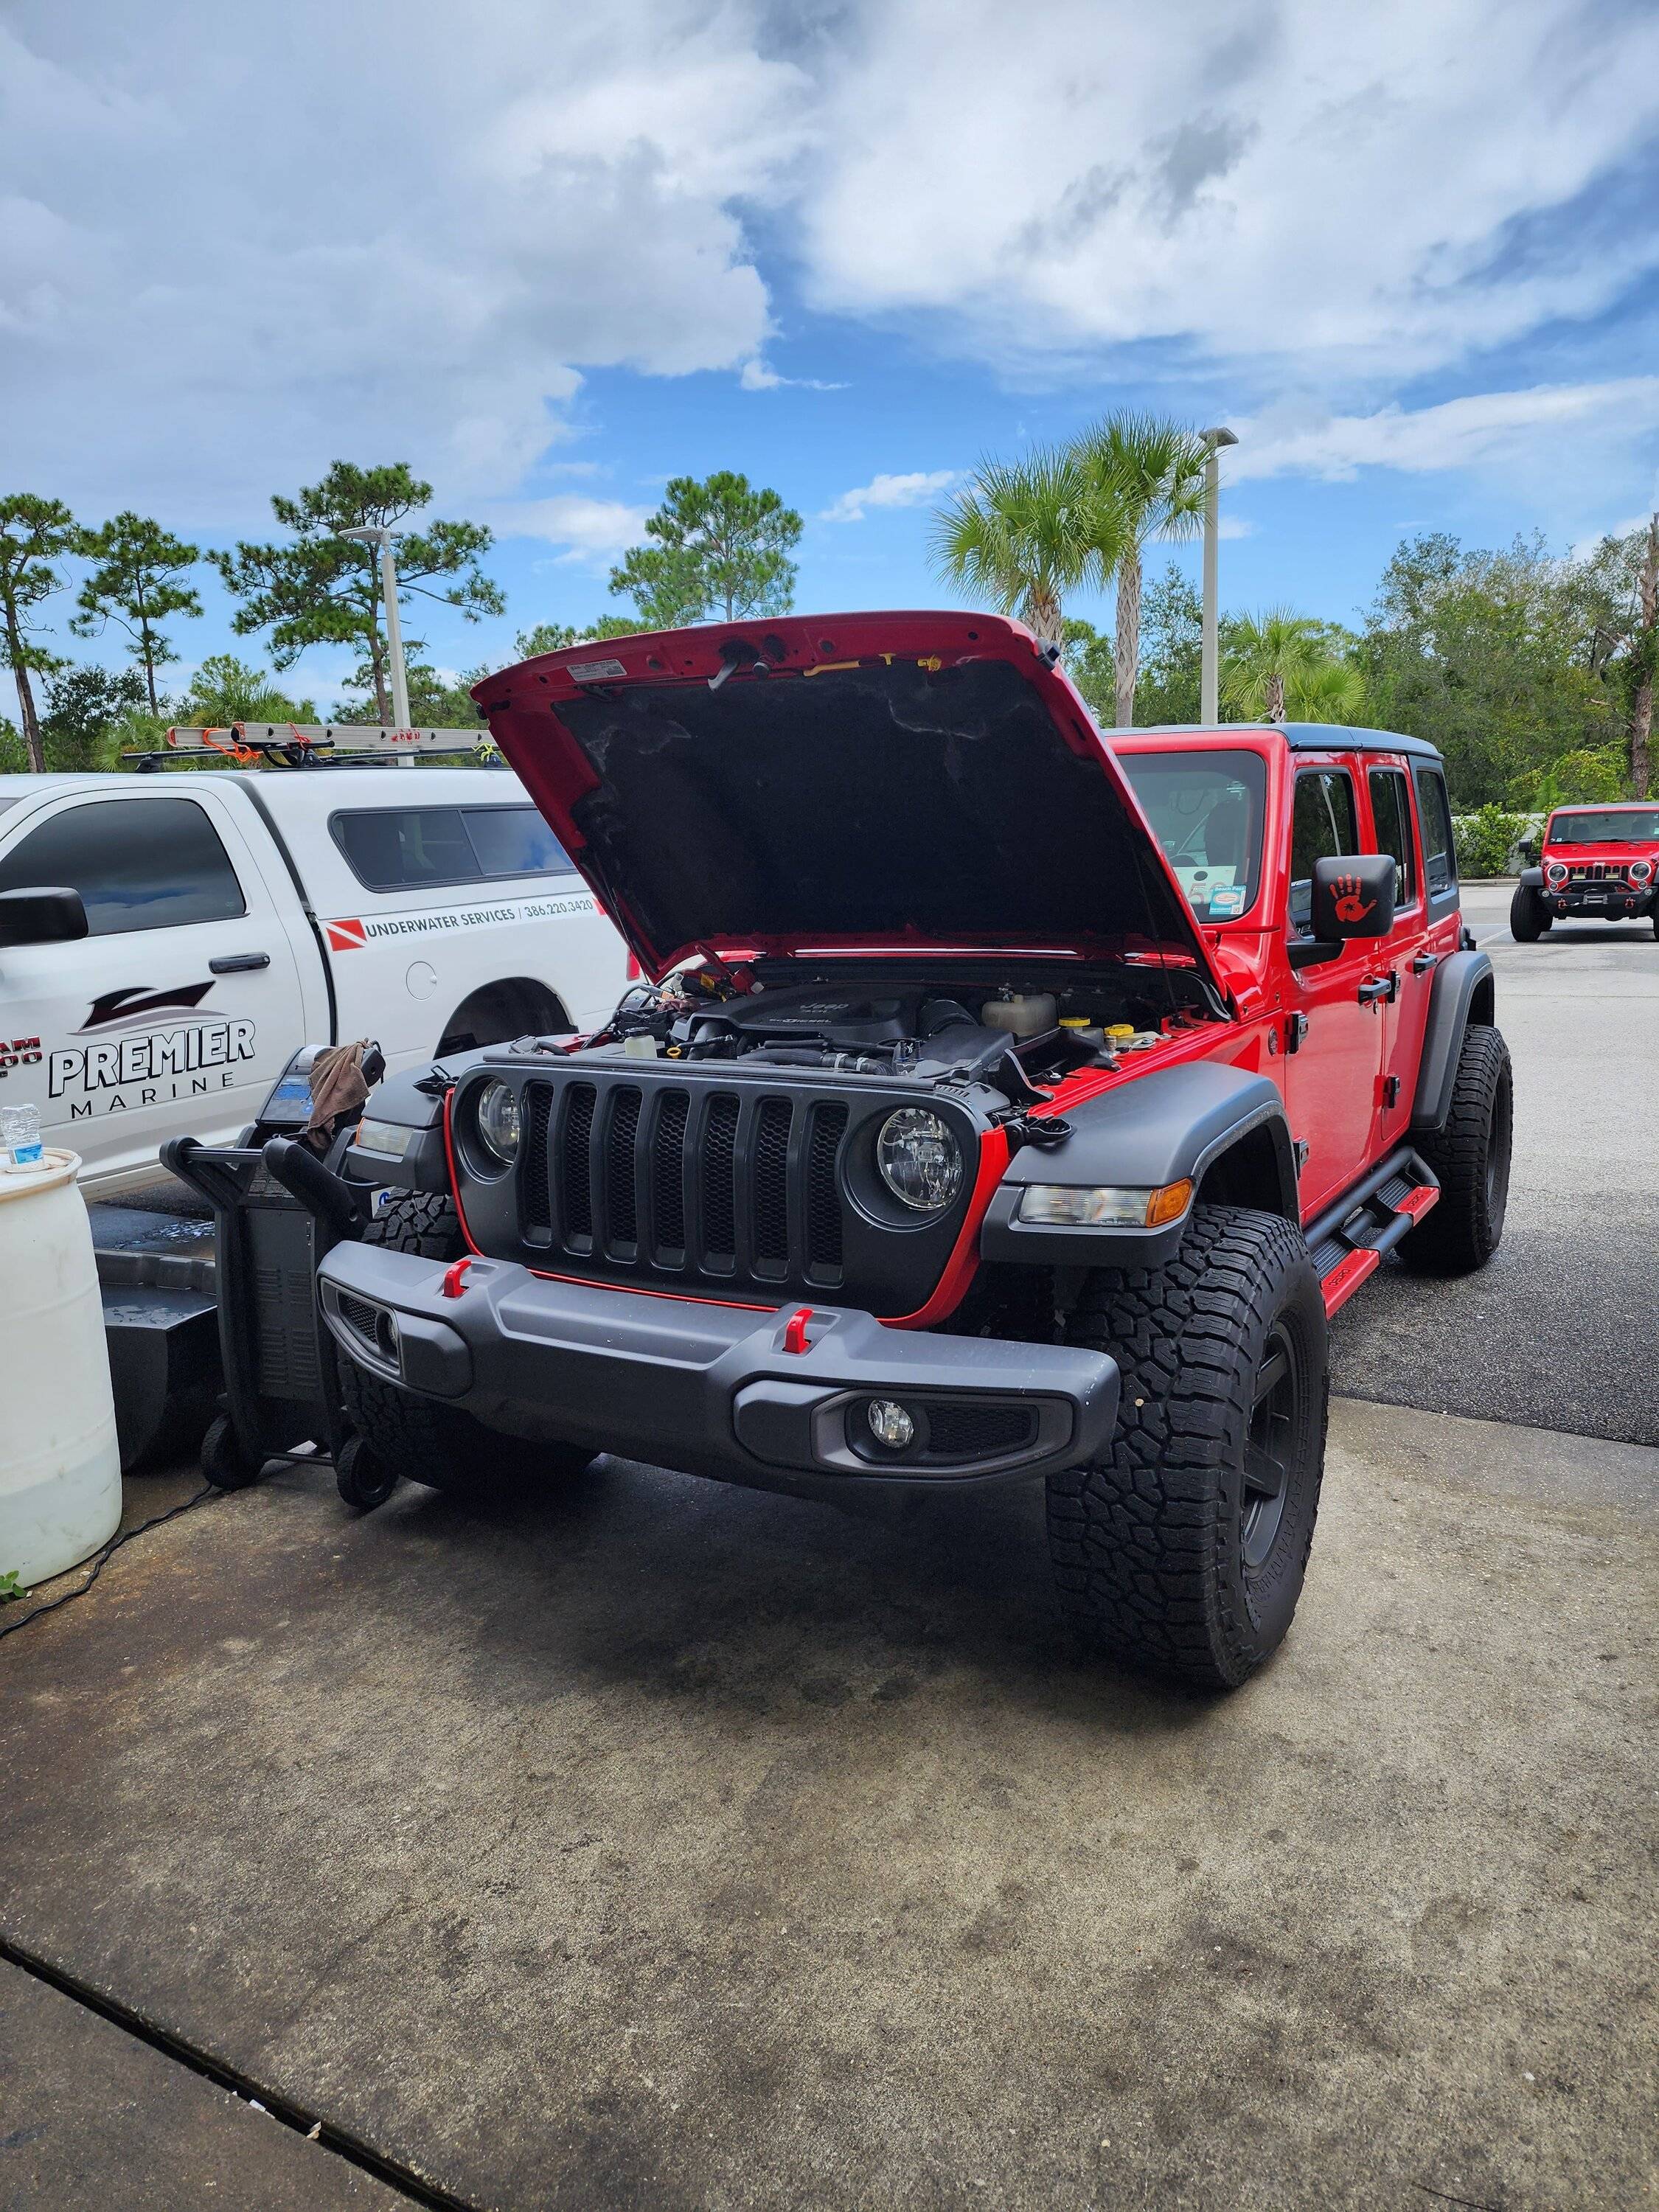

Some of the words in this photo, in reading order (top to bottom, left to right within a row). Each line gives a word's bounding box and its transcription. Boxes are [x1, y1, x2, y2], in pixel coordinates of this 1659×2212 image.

[366, 915, 459, 938] UNDERWATER
[462, 908, 515, 926] SERVICES
[524, 899, 594, 918] 386.220.3420
[49, 1019, 256, 1098] PREMIER
[71, 1071, 234, 1119] MARINE
